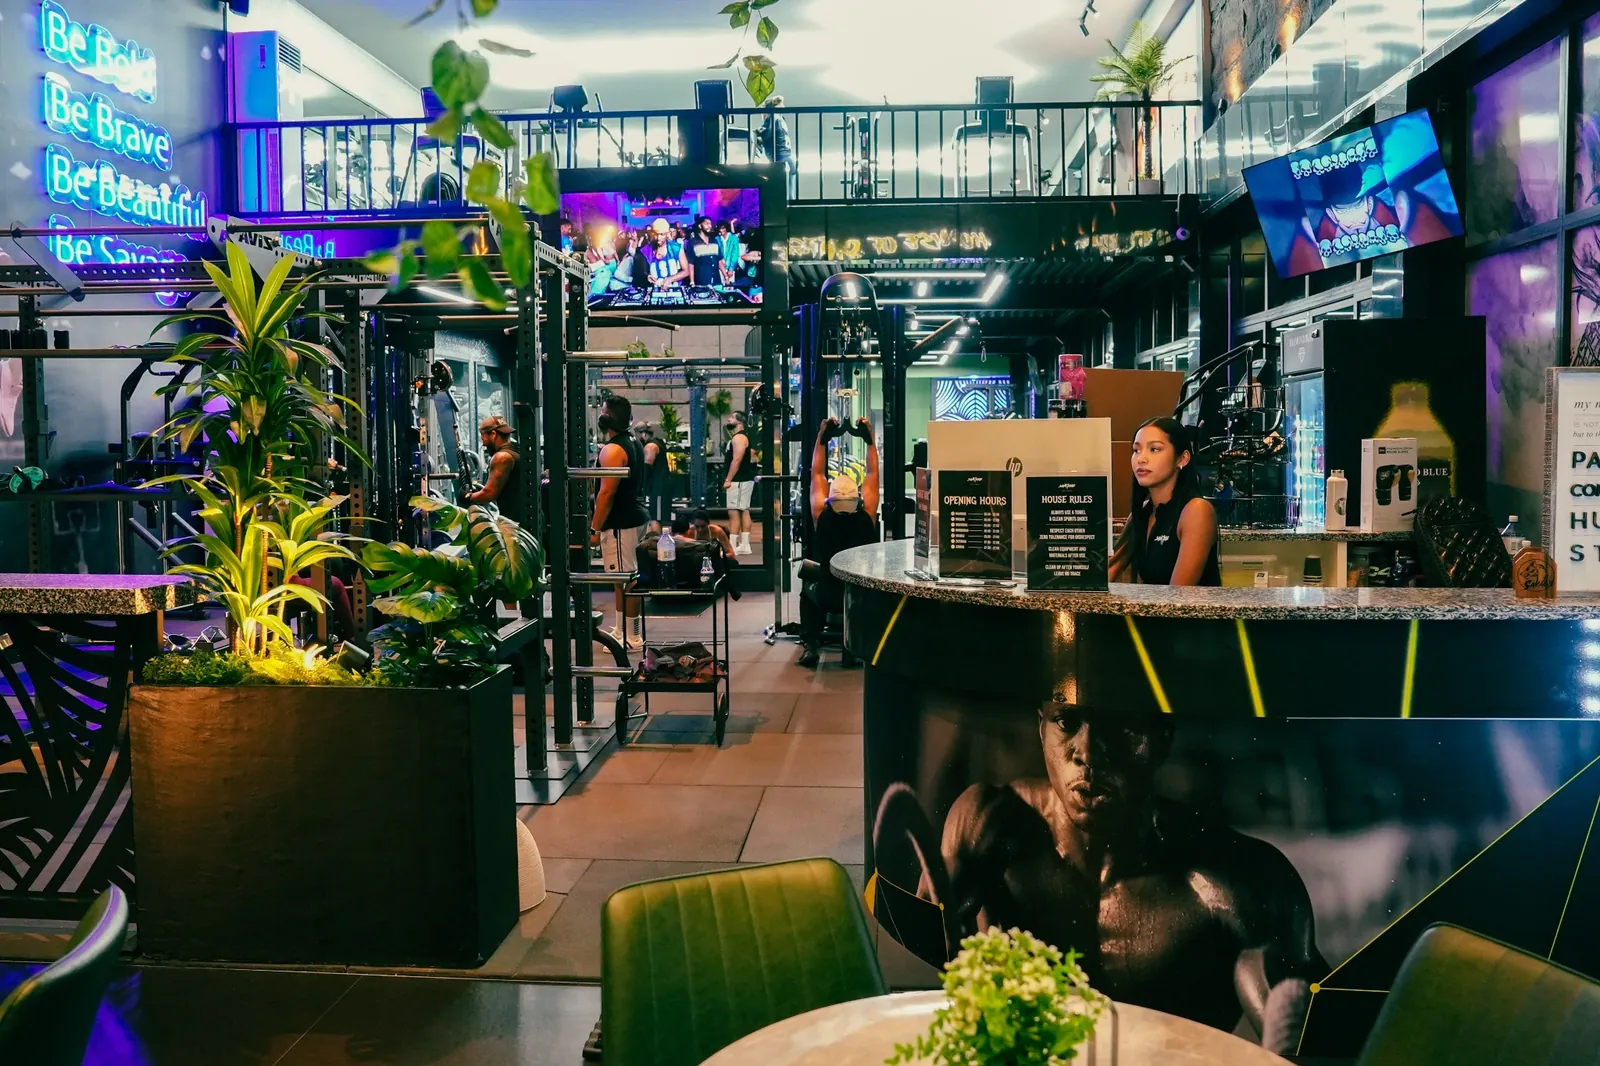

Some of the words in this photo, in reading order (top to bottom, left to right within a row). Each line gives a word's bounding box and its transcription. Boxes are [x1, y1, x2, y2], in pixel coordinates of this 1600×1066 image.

[49, 11, 86, 63] Be
[95, 35, 156, 93] Bol
[51, 82, 89, 132] Be
[96, 102, 170, 163] Brave
[53, 154, 91, 200] Be
[99, 167, 206, 227] Beautiful
[56, 225, 93, 265] Be
[1574, 401, 1592, 412] my
[1007, 457, 1022, 477] hp
[1571, 451, 1600, 469] PA
[1423, 468, 1449, 476] BLUE
[943, 495, 977, 506] OPENING
[979, 496, 1007, 506] HOURS
[1041, 495, 1067, 504] HOUSE
[1069, 495, 1093, 505] RULES
